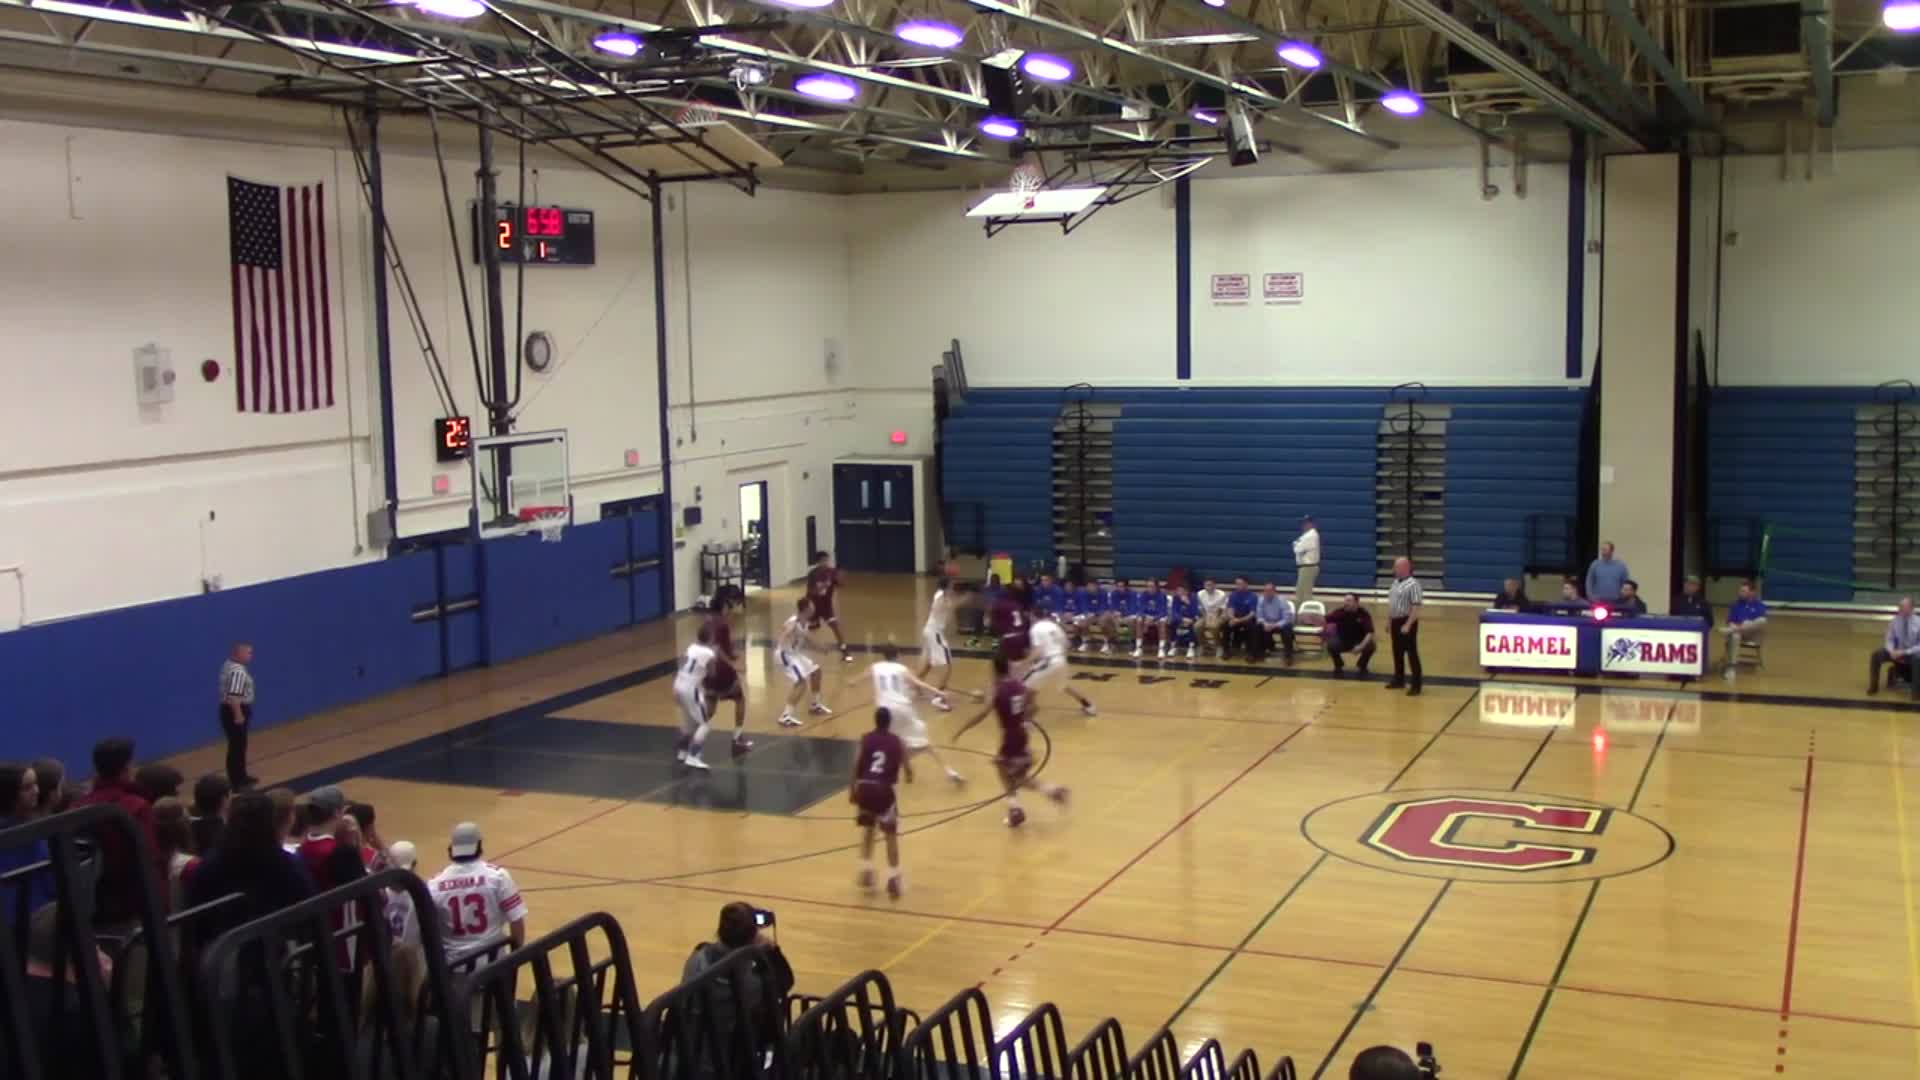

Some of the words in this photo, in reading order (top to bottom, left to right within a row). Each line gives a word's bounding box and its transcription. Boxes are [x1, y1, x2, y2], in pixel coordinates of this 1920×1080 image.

[498, 222, 511, 248] 2
[539, 240, 546, 258] 1
[1485, 634, 1571, 656] CARMEL
[1639, 642, 1698, 664] RAMS
[869, 751, 886, 773] 2
[1357, 795, 1614, 872] C
[447, 893, 488, 937] 13
